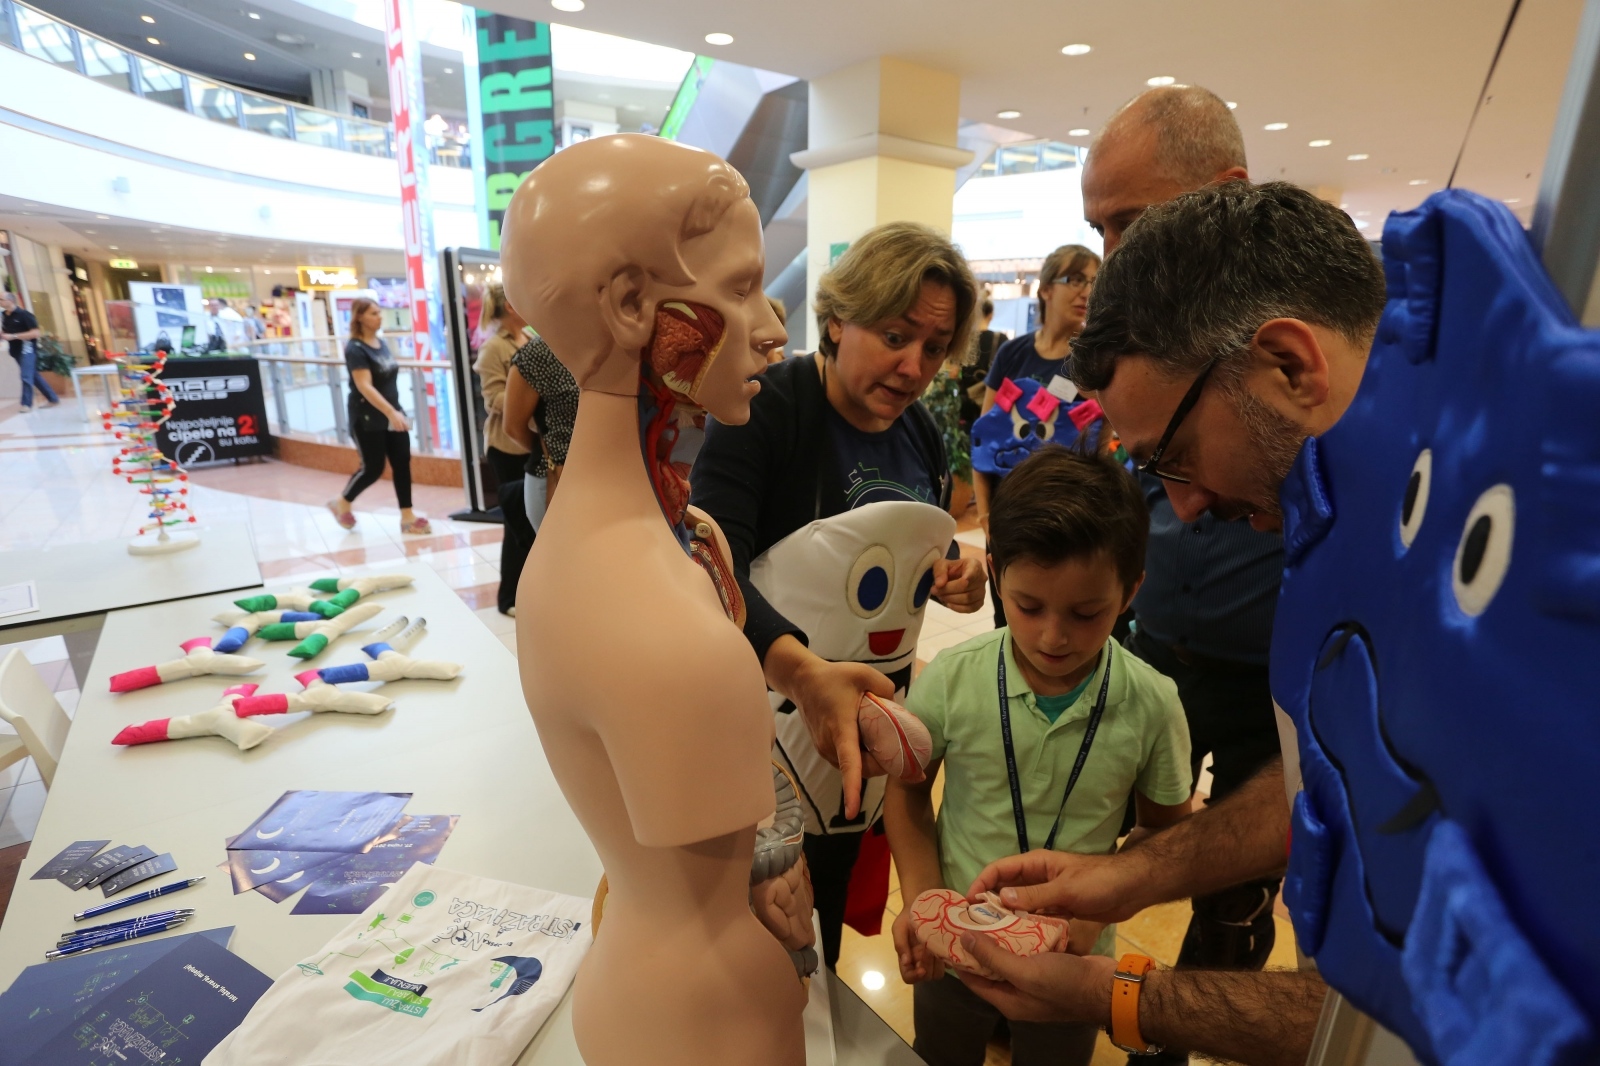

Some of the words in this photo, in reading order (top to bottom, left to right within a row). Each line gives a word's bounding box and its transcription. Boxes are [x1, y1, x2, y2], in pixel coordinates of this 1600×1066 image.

[168, 428, 214, 444] cipele
[217, 427, 237, 437] na
[237, 415, 255, 435] 2
[219, 438, 233, 447] su
